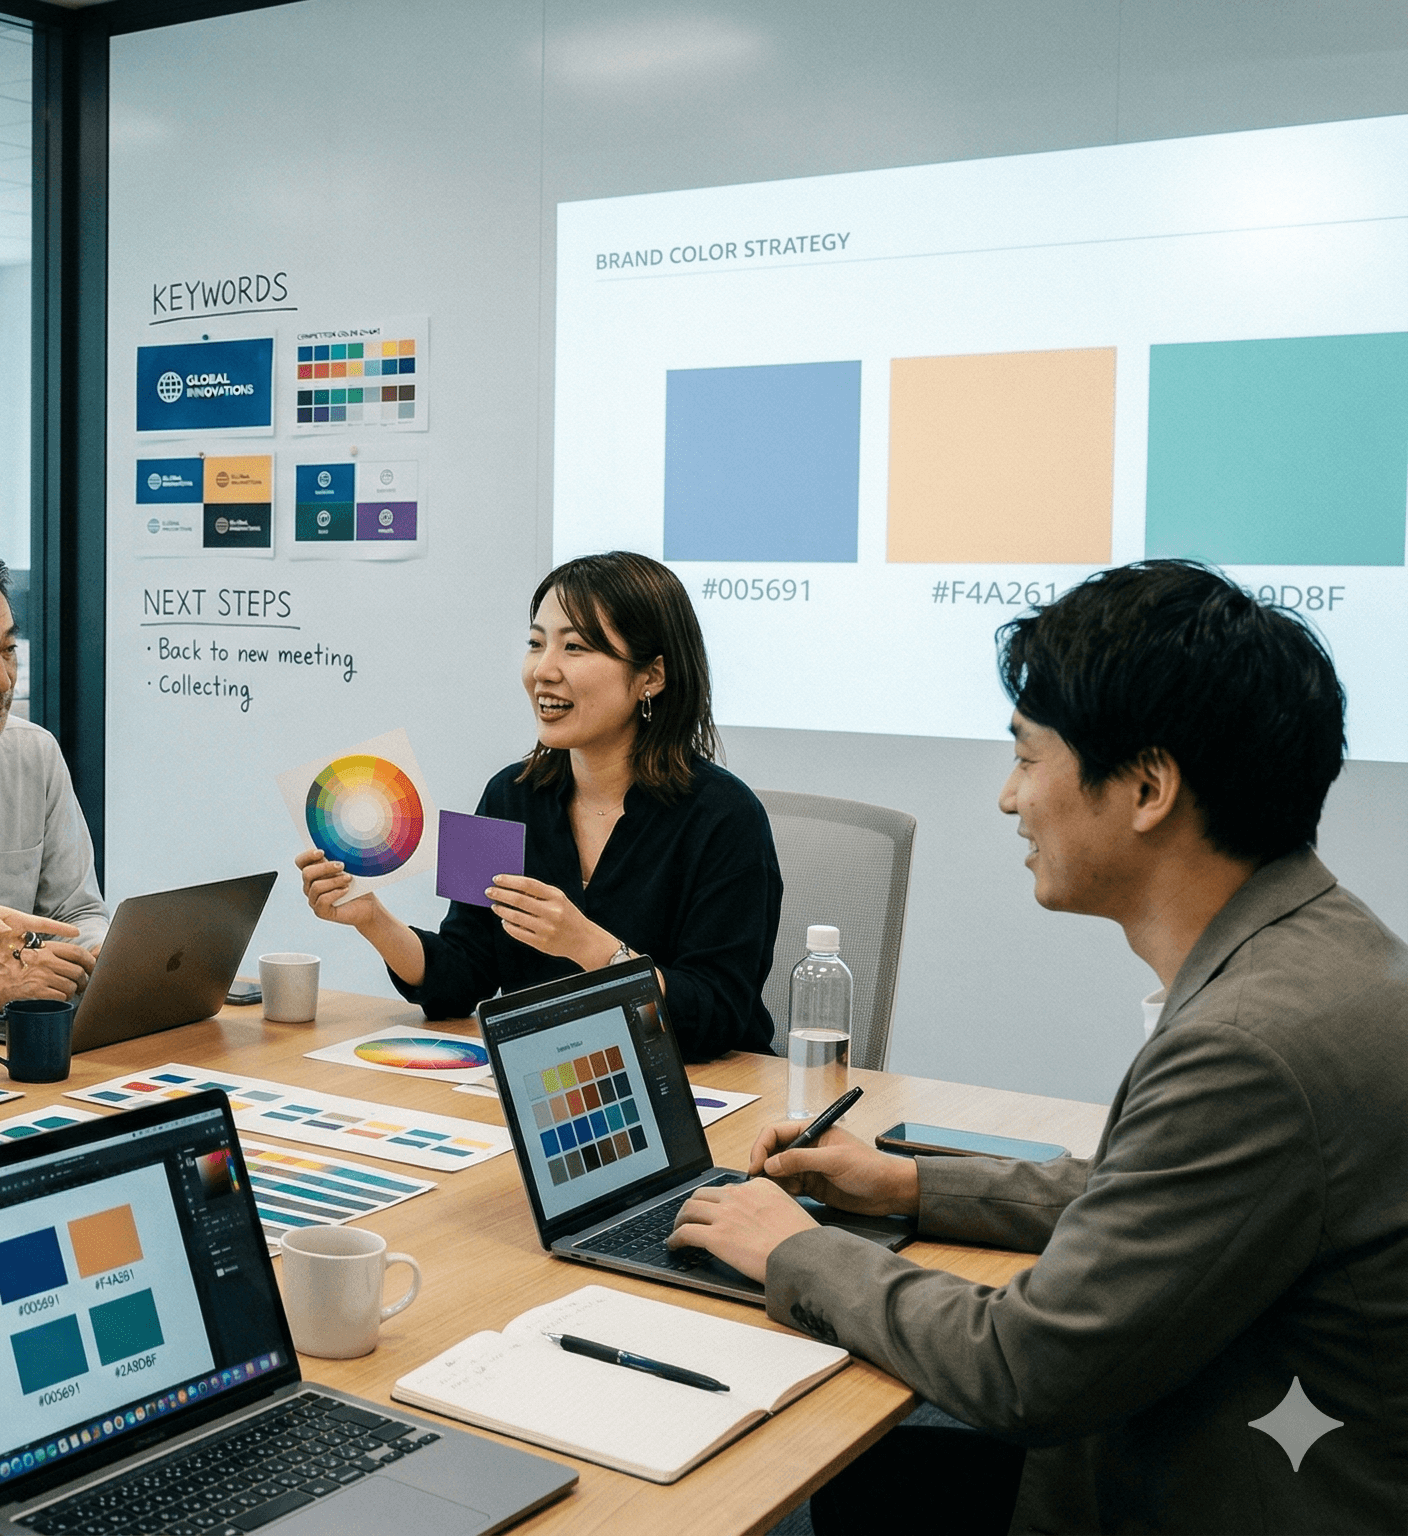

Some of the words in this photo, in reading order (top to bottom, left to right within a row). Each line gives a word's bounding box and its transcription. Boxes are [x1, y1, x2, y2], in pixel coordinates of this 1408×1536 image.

[596, 249, 663, 270] BRAND
[669, 242, 737, 264] COLOR
[744, 231, 851, 258] STRATEGY
[153, 272, 288, 315] KEYWORDS
[186, 373, 231, 386] GLOBAL
[186, 384, 255, 398] INNOVATIONS
[144, 588, 206, 616] NEXT
[218, 588, 292, 618] STEPS
[702, 578, 811, 602] #005691
[932, 581, 1057, 606] #F4A261
[158, 637, 202, 661] Back
[210, 640, 228, 661] to
[238, 647, 269, 663] new
[278, 643, 358, 683] meeting
[158, 674, 253, 713] Collecting
